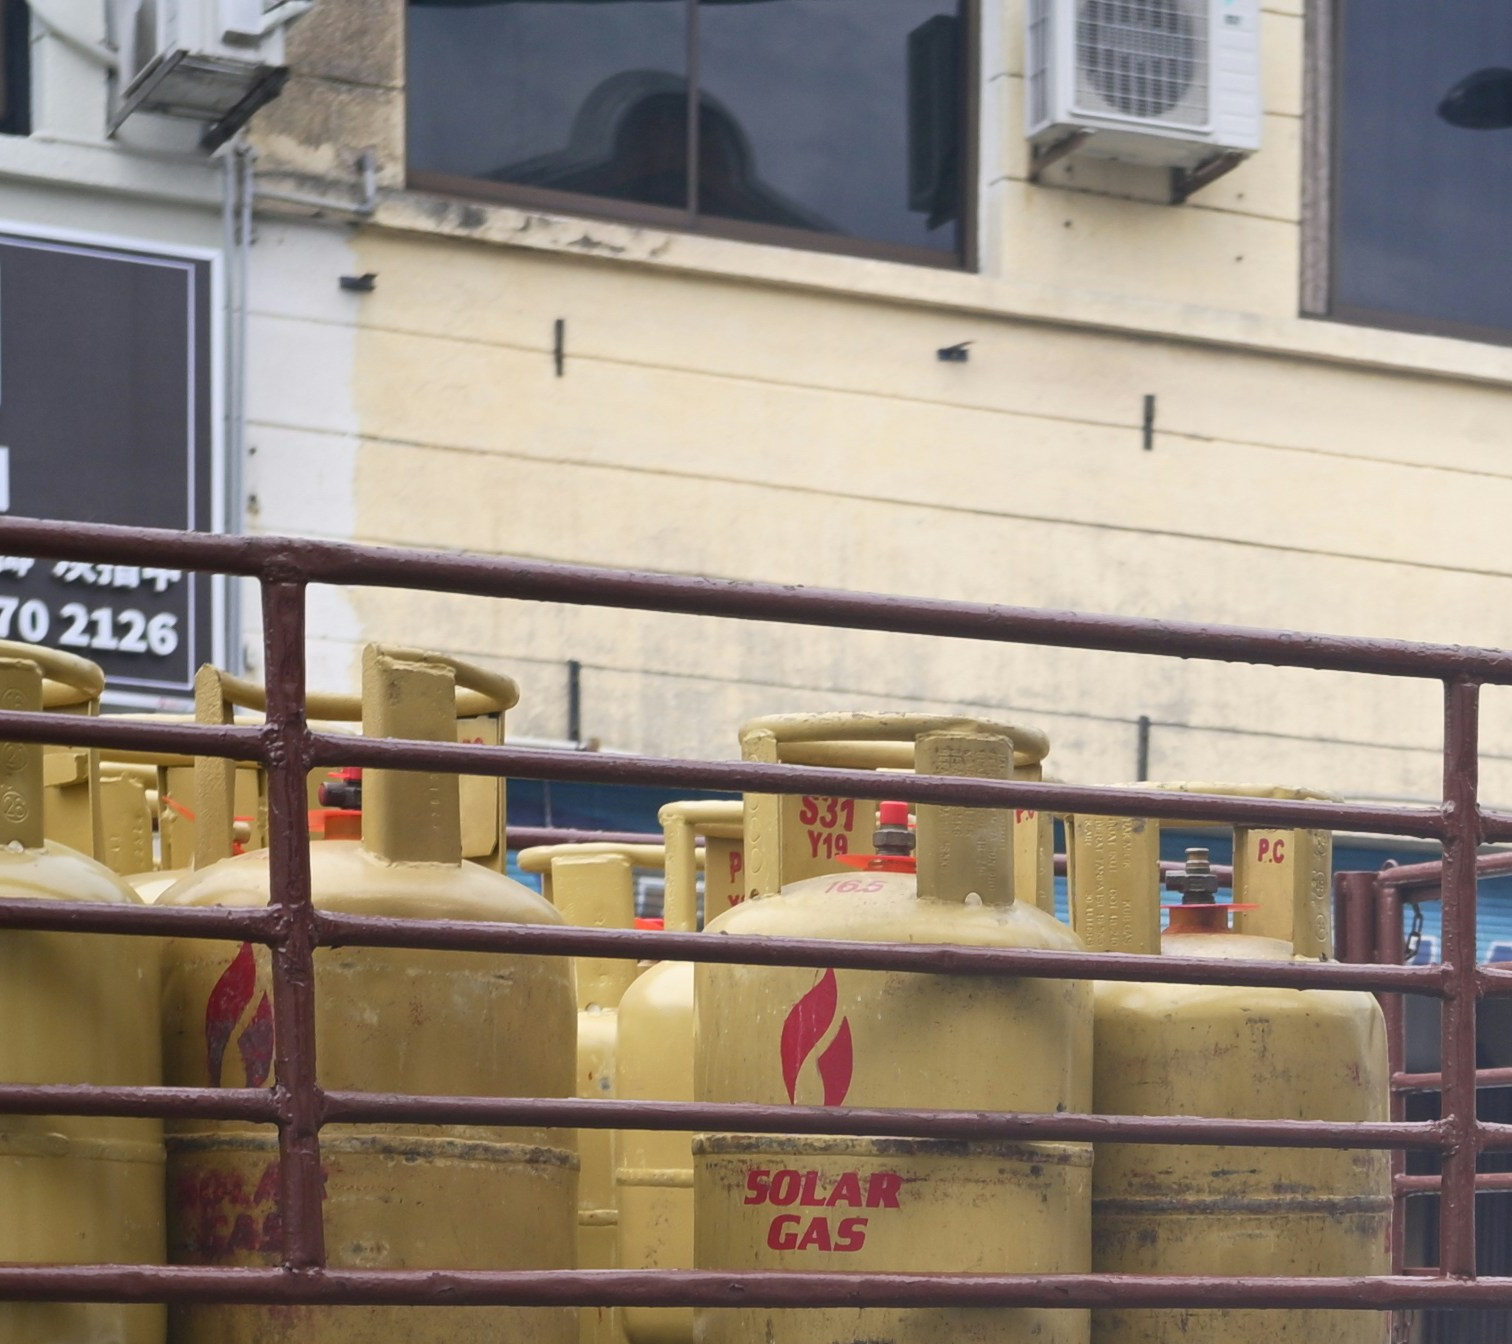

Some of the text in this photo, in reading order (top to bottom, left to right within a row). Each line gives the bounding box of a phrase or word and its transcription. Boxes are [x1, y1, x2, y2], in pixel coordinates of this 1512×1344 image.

[58, 601, 180, 657] 2126
[1257, 836, 1286, 866] P.C
[743, 1169, 902, 1210] SOLAR
[766, 1214, 869, 1253] GAS
